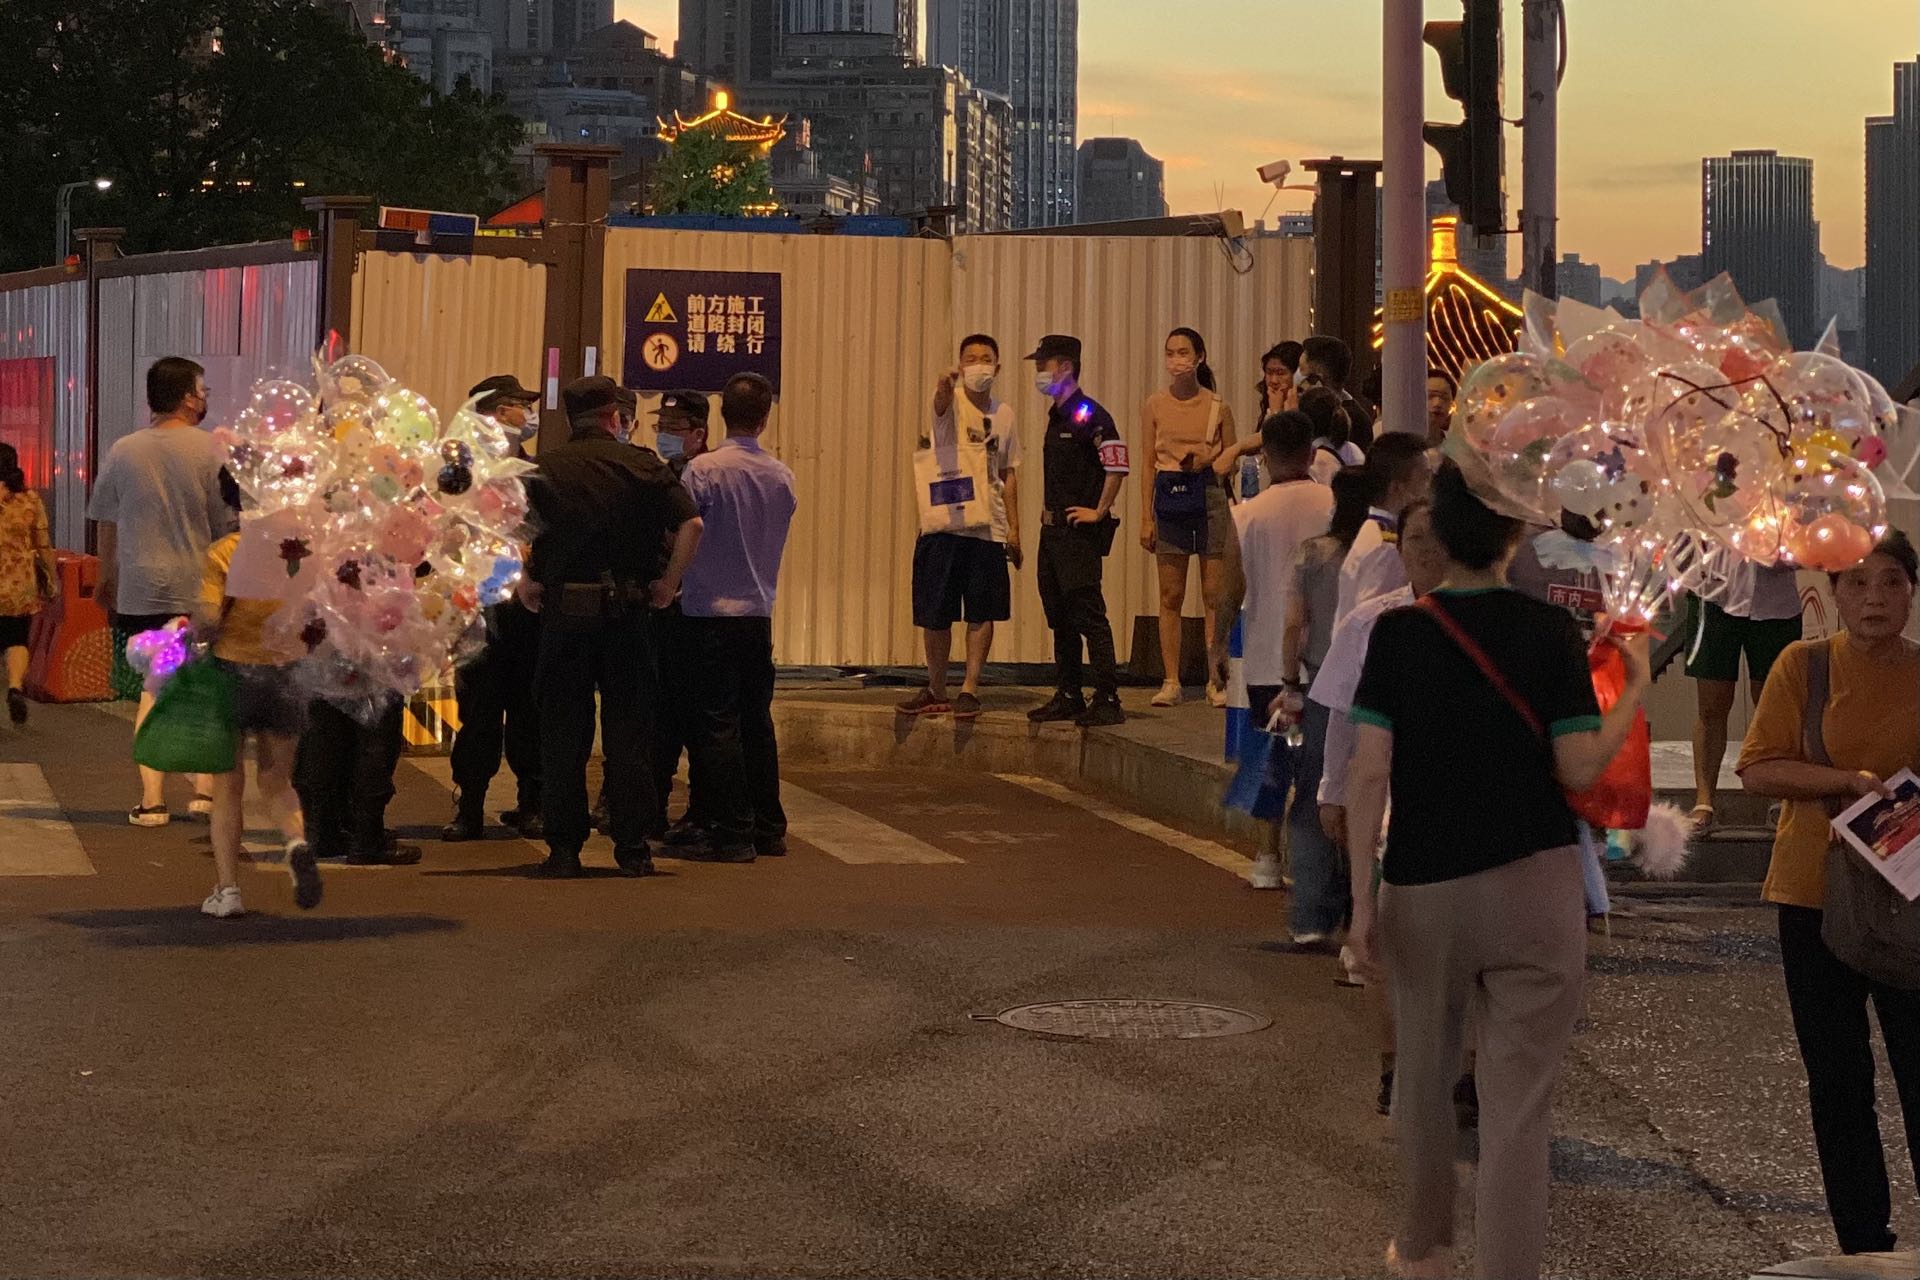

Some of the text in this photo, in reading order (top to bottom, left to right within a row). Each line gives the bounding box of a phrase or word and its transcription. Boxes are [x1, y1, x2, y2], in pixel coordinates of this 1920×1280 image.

[687, 294, 765, 314] 前方施工
[687, 314, 765, 334] 道路封闭
[687, 334, 765, 354] 请绕行
